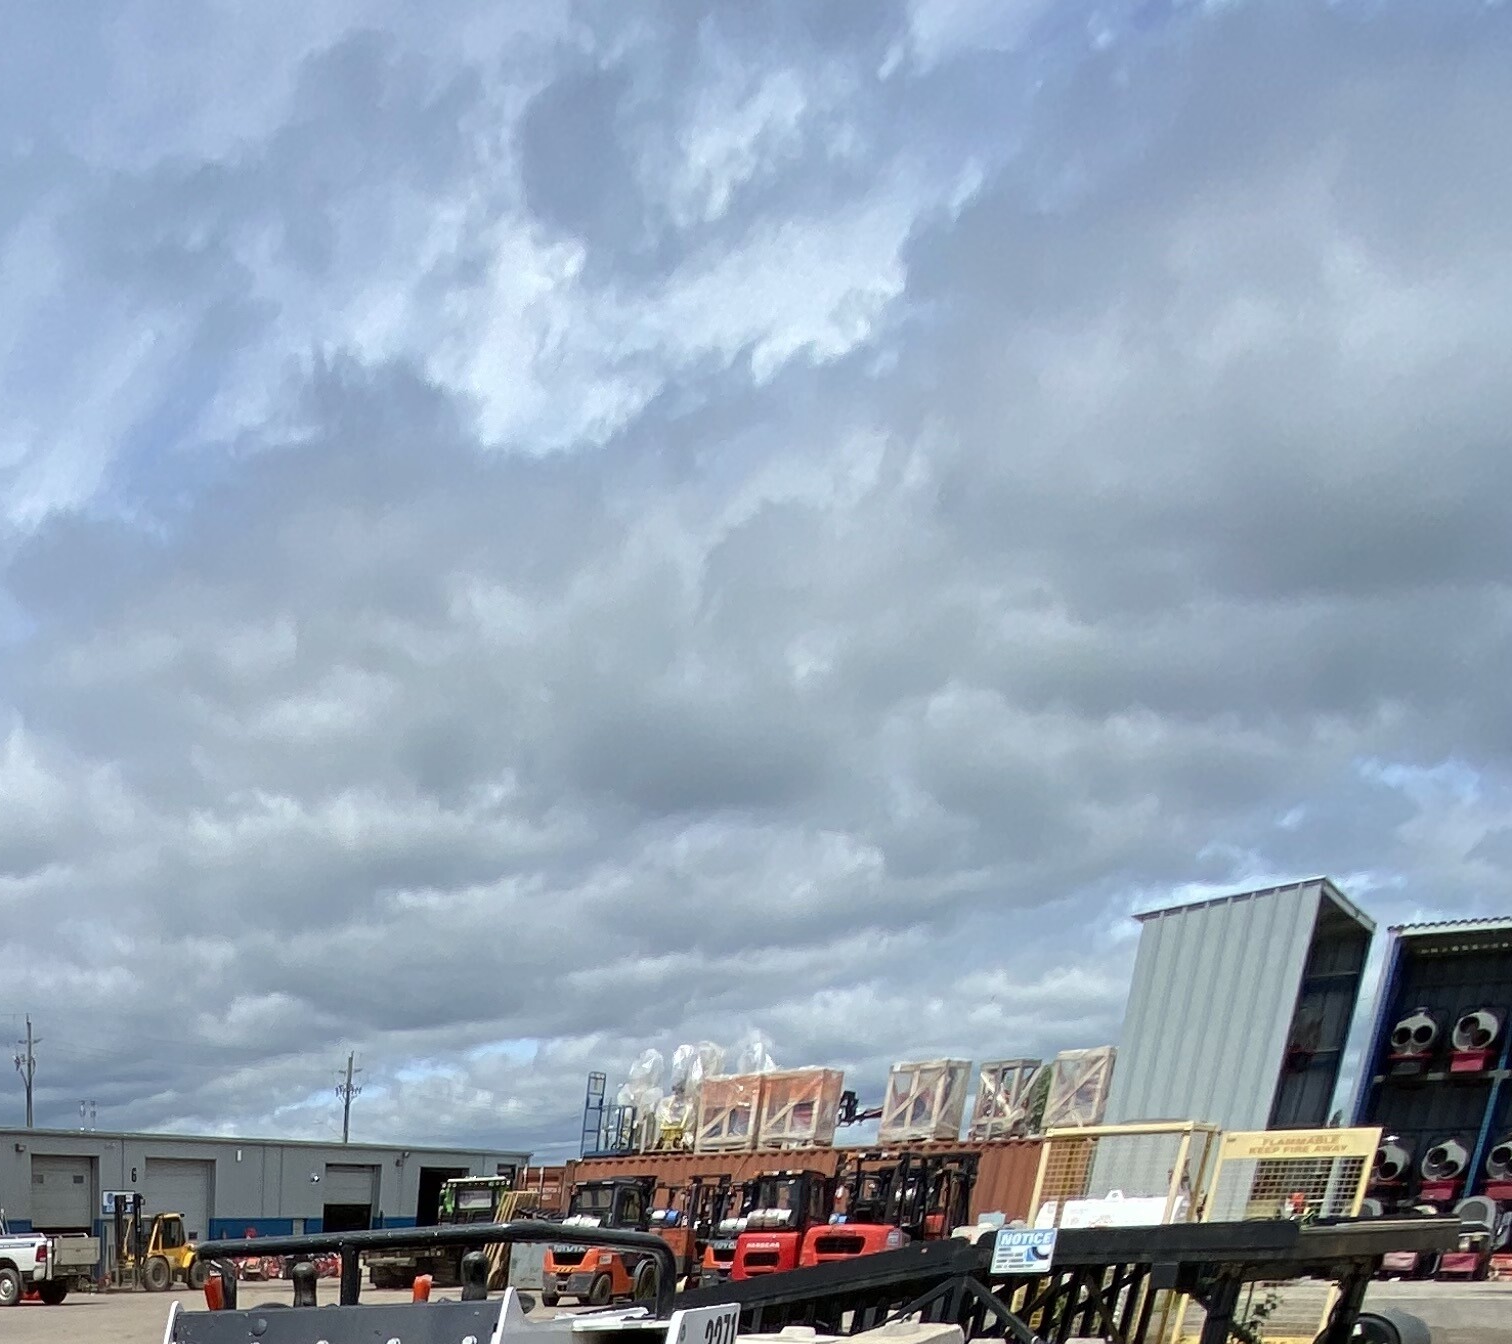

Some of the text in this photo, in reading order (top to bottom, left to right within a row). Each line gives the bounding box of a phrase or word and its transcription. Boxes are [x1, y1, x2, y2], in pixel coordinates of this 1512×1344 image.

[1262, 1134, 1341, 1146] FLAMMABLE
[1249, 1144, 1348, 1155] KEEP FIRE AWAY
[131, 1167, 137, 1182] 6
[1000, 1231, 1054, 1246] NOTICE
